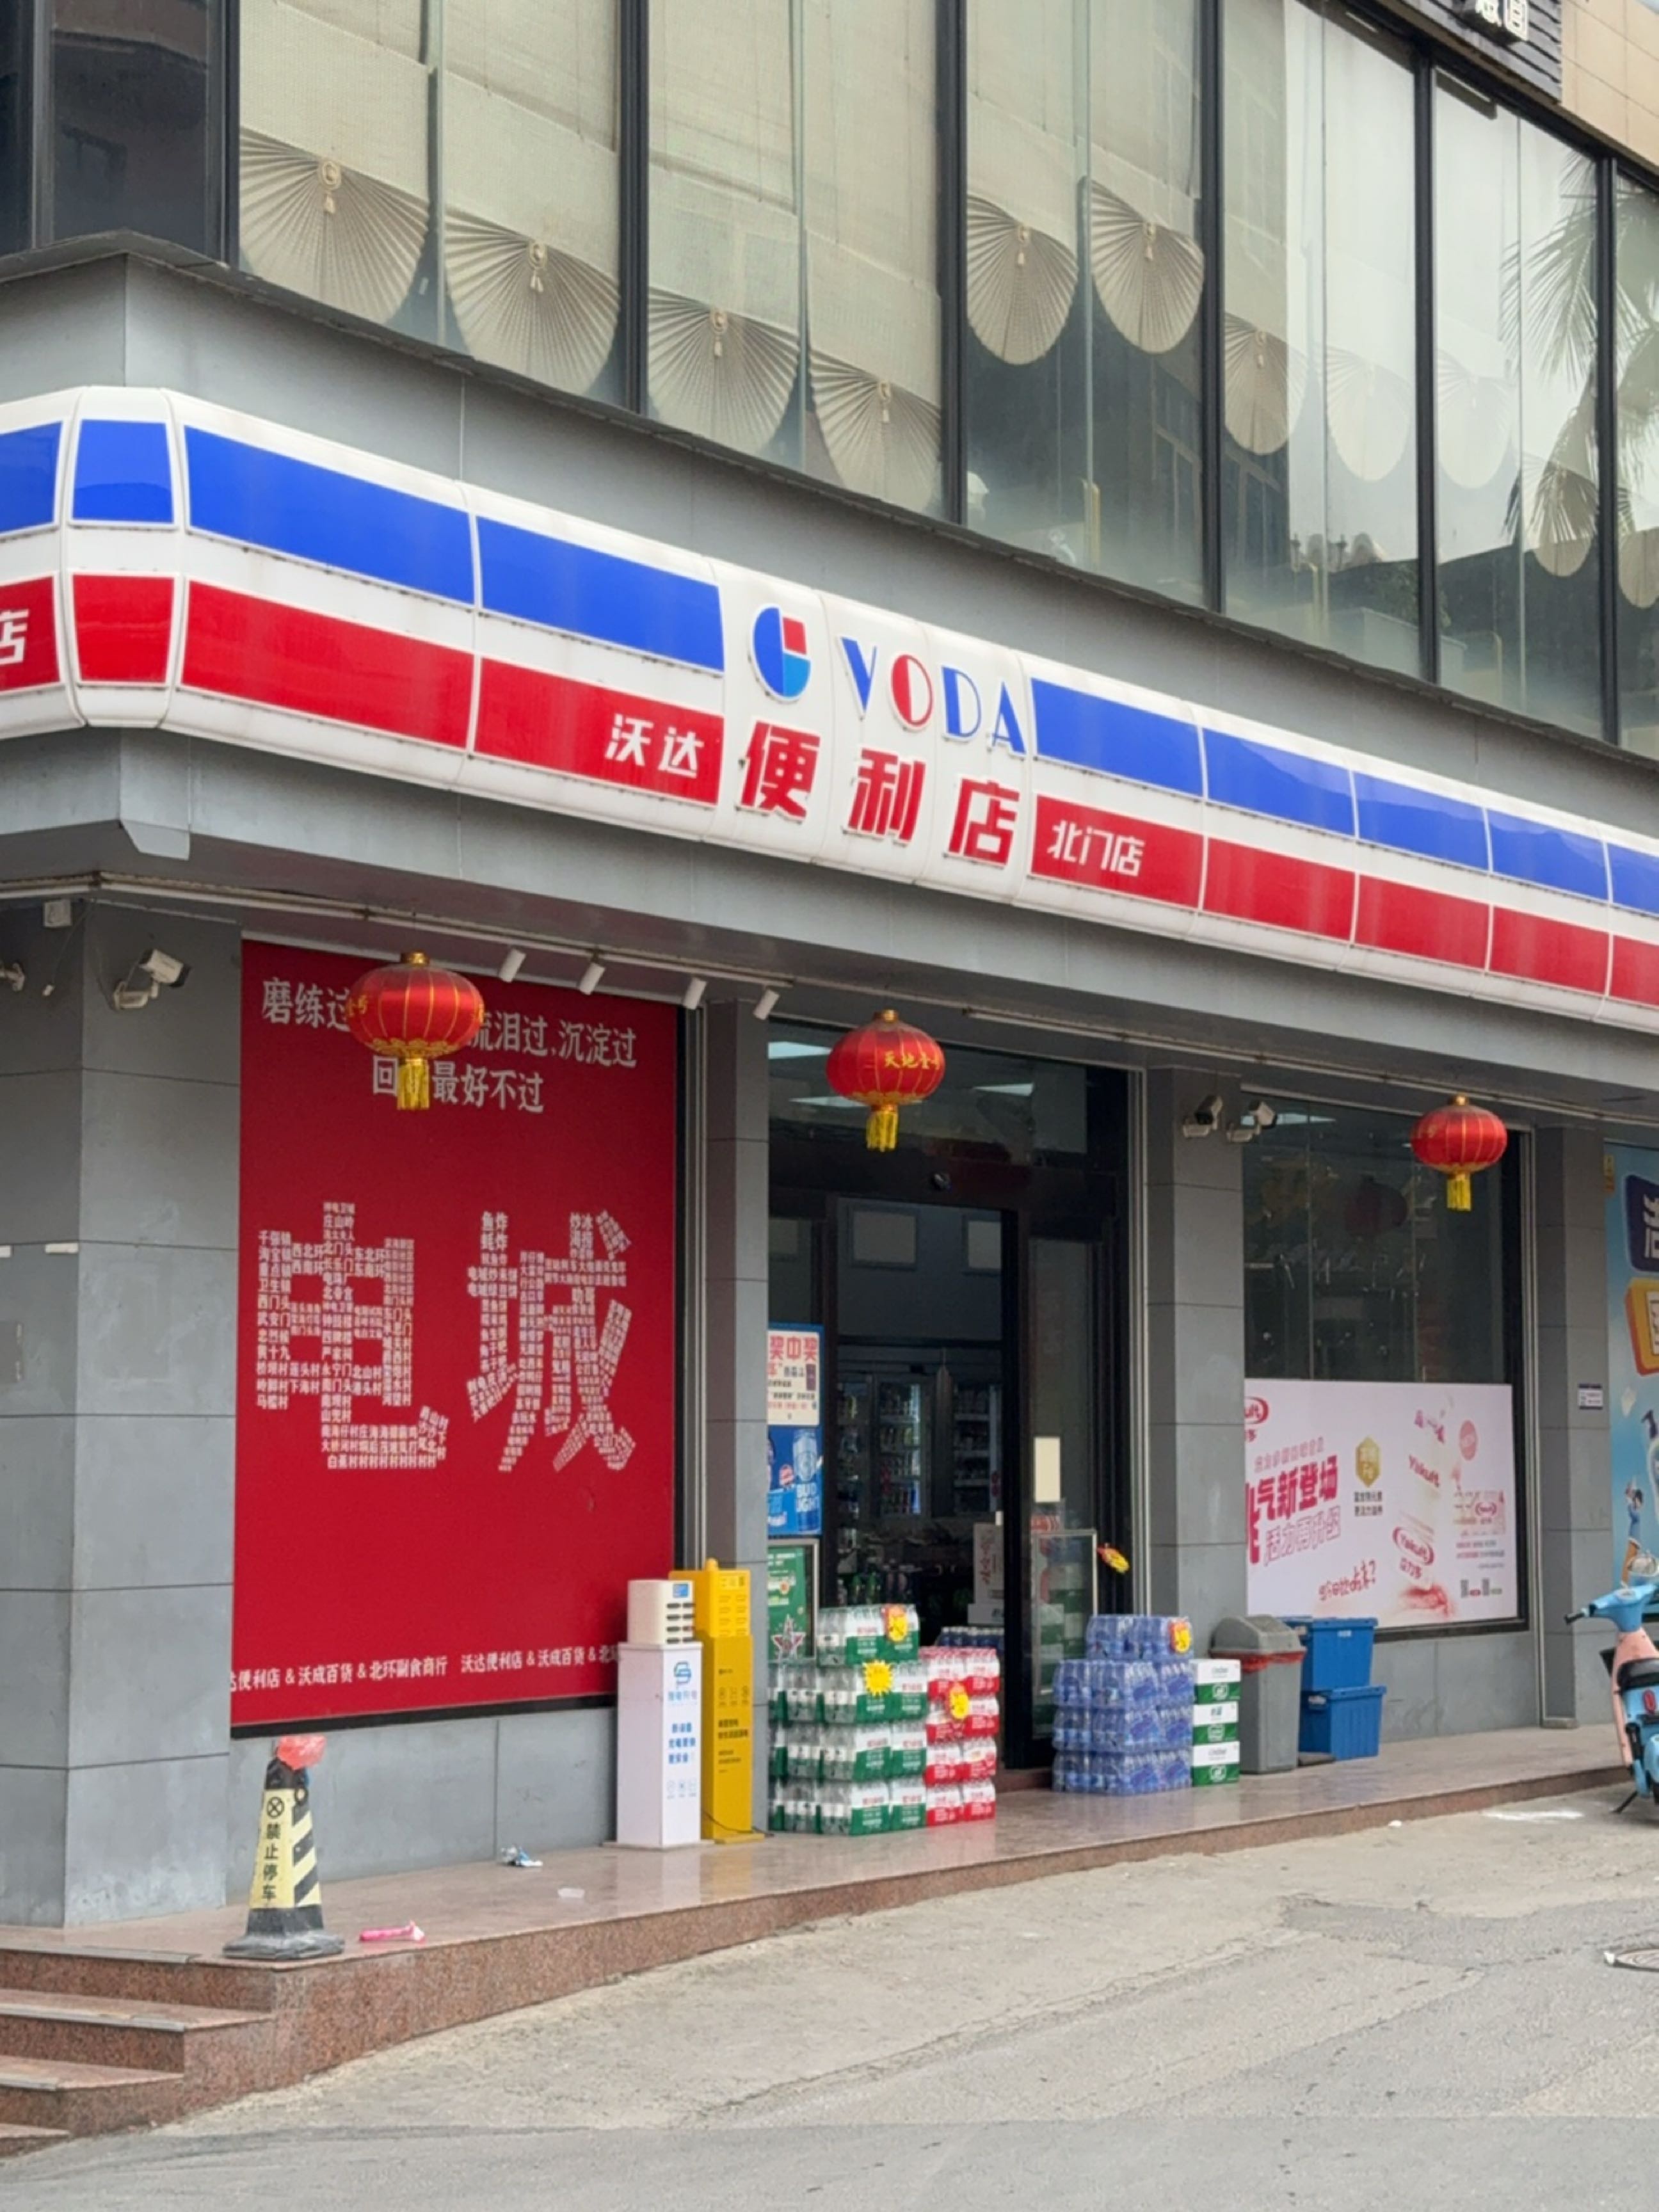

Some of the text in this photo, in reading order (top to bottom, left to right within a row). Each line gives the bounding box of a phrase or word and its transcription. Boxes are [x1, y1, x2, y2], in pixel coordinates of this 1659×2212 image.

[838, 636, 1026, 754] VODA
[604, 712, 705, 779] 沃达
[741, 719, 1020, 868] 便利店
[1047, 816, 1145, 878] 北门店
[373, 1057, 544, 1114] 回最好不过
[261, 1823, 280, 1901] 禁止停车
